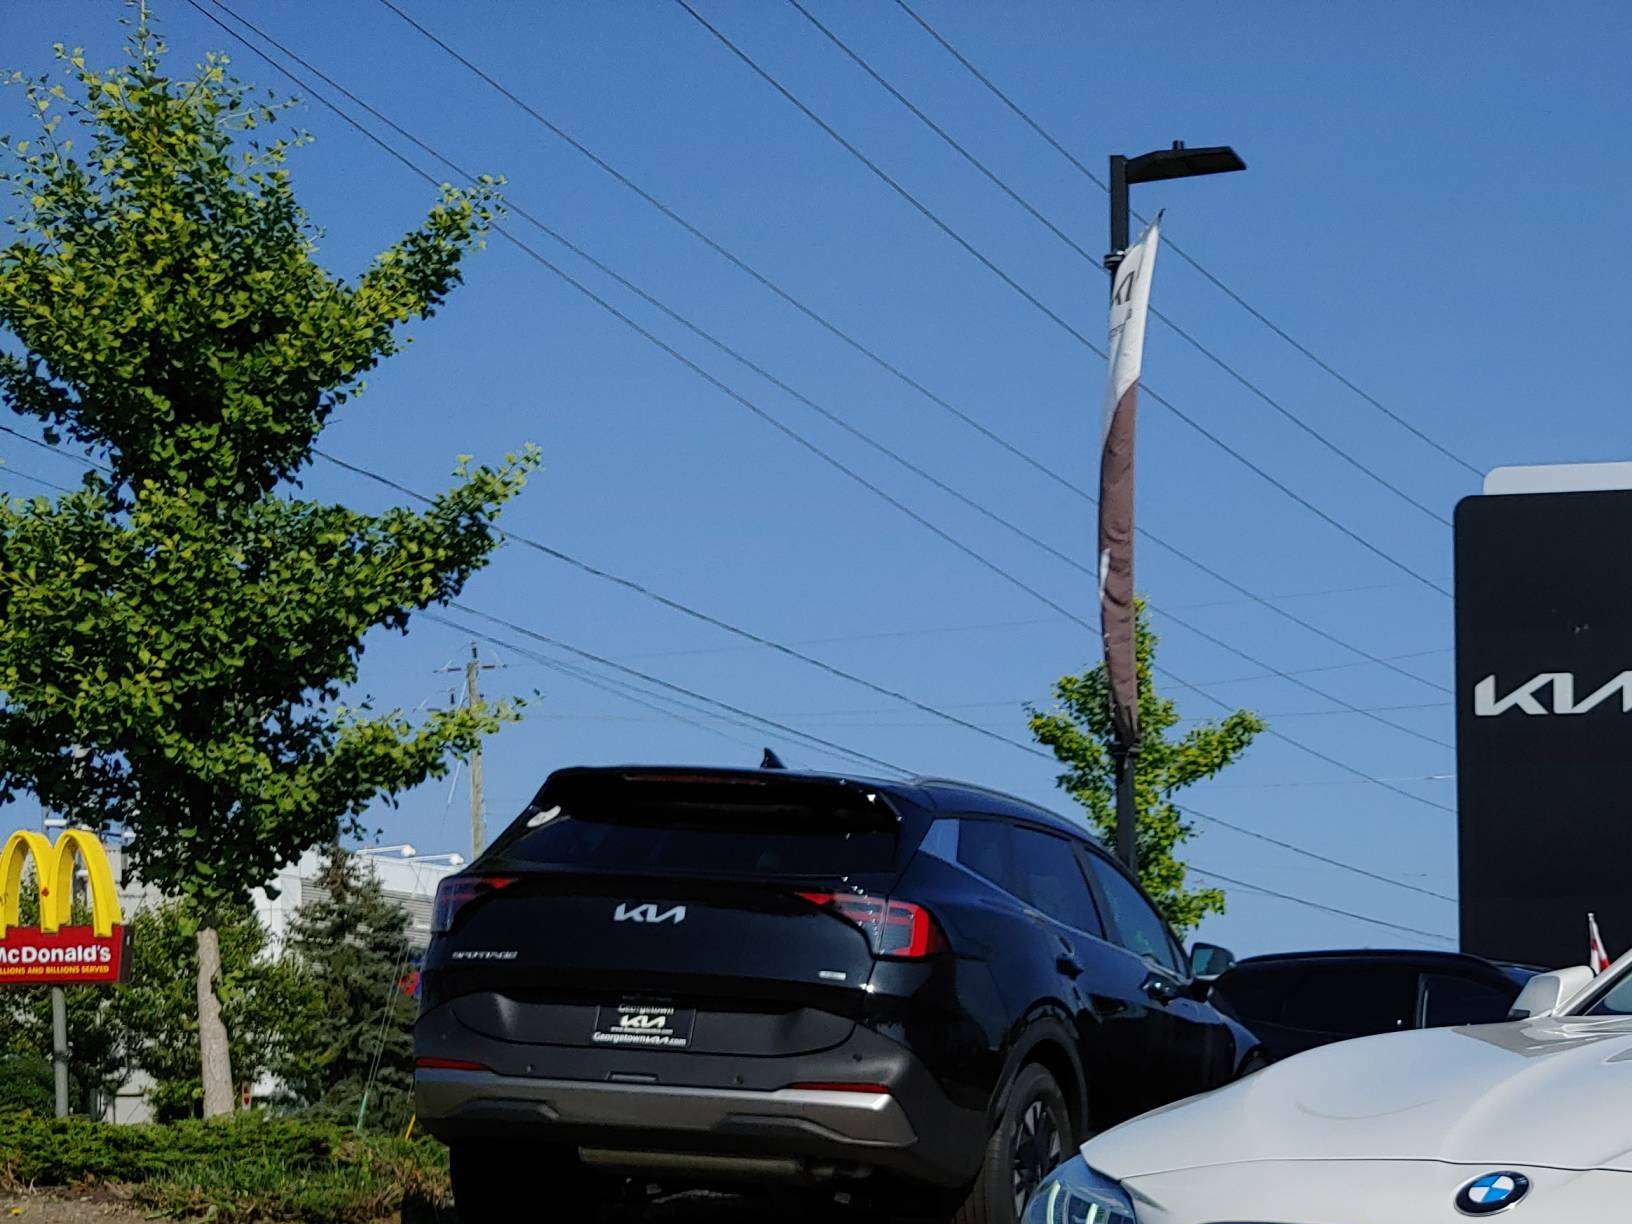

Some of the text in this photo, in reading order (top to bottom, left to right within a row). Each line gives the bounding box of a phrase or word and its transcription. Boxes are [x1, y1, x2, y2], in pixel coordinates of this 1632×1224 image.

[613, 903, 686, 924] KIA
[45, 966, 80, 975] BILLIONS
[620, 1014, 666, 1028] KIA
